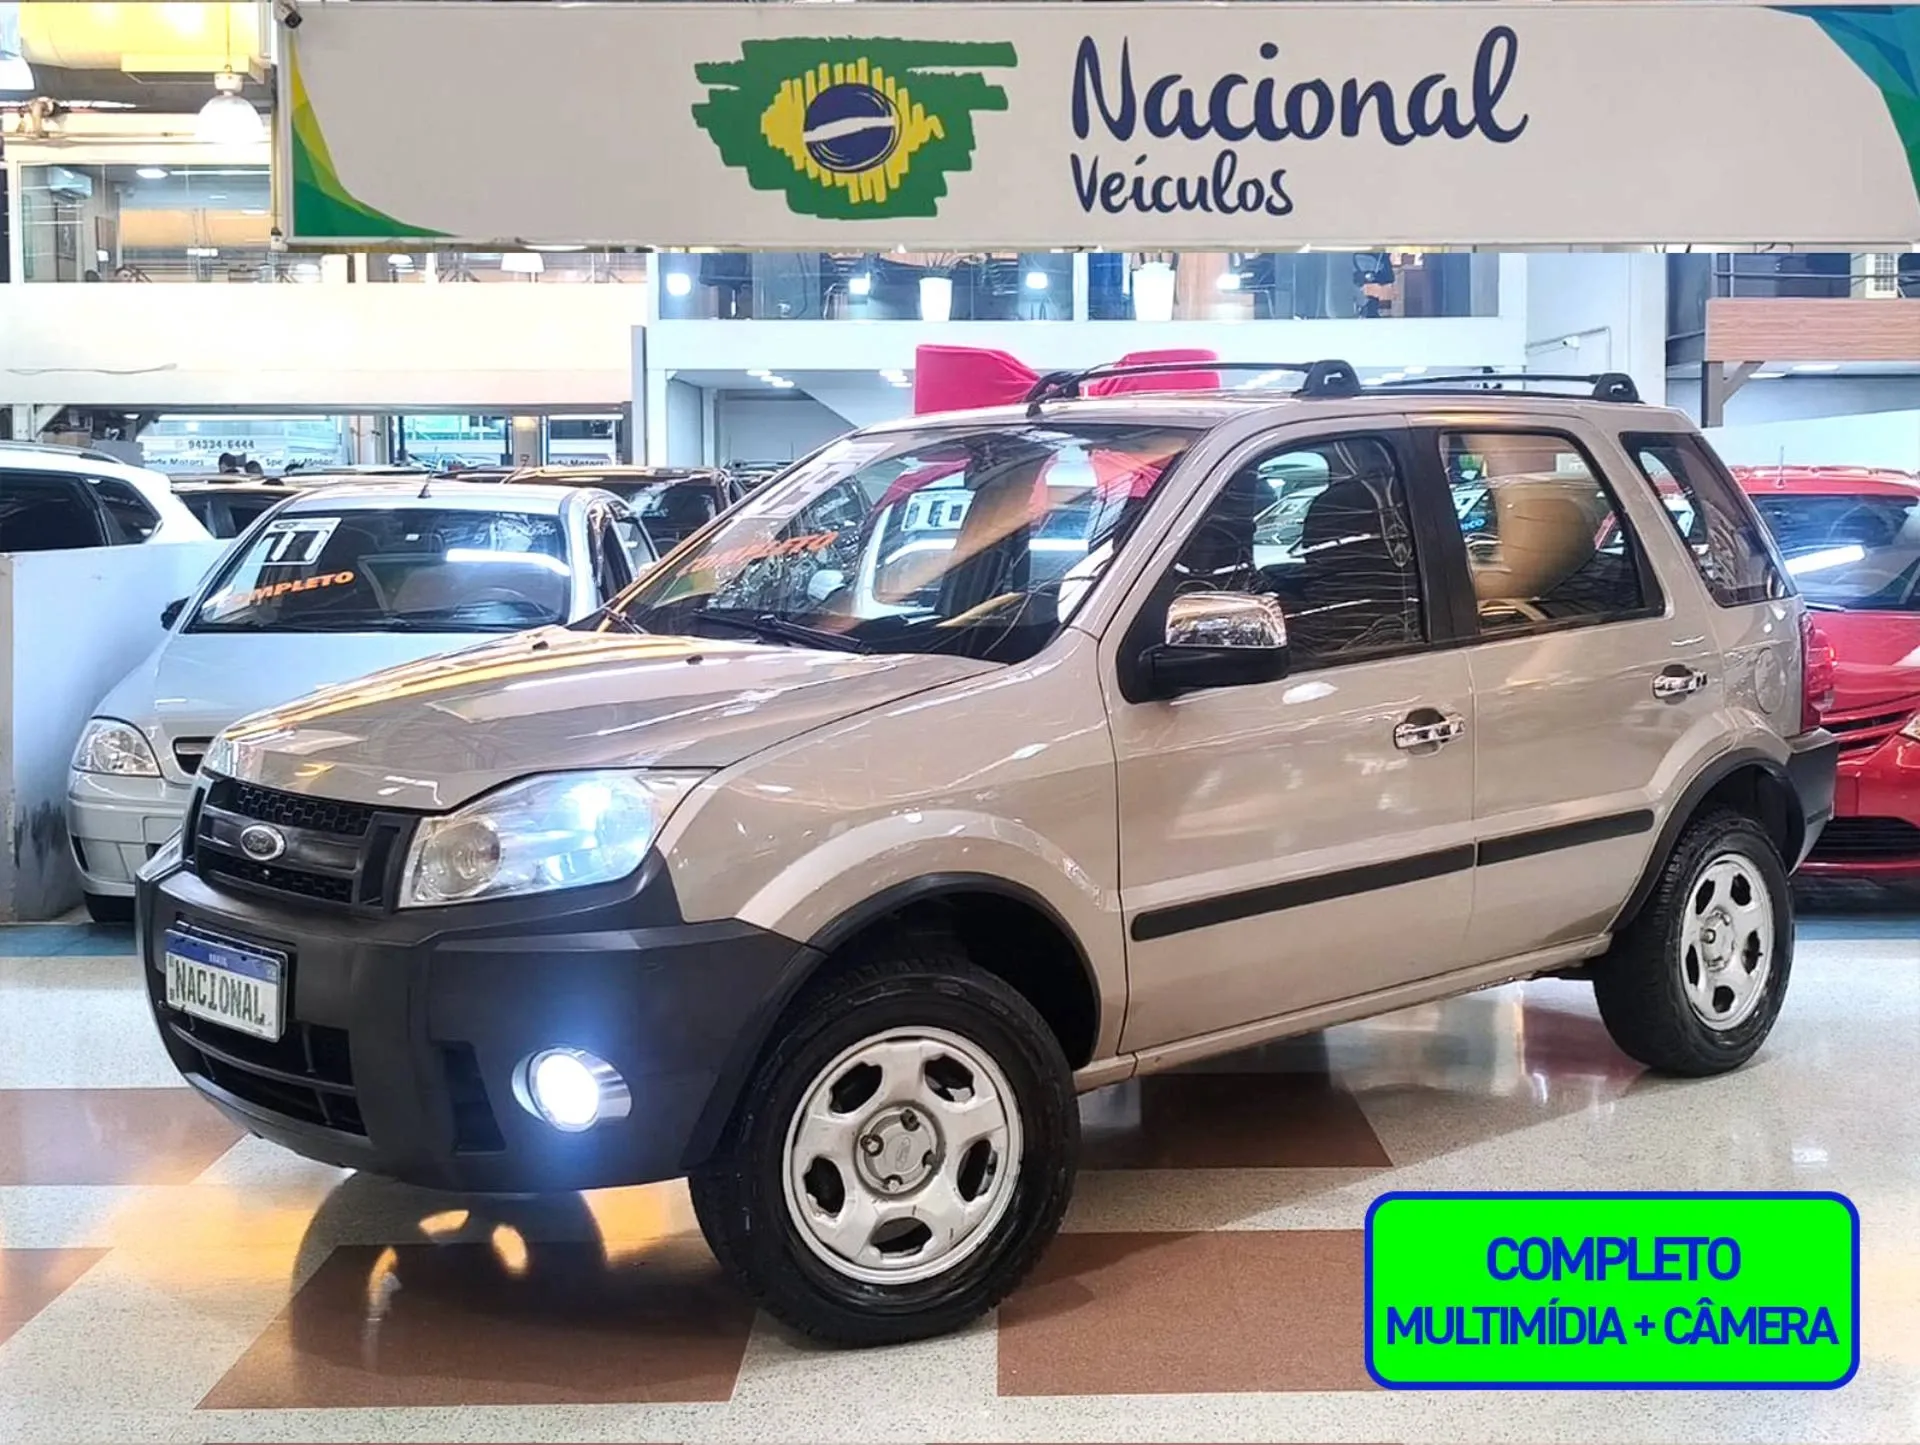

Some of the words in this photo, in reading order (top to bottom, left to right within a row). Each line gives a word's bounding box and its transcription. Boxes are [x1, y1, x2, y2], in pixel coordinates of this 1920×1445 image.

[1071, 25, 1529, 146] Nacional
[1070, 149, 1294, 216] Veículos
[174, 958, 266, 1026] NACIONAL
